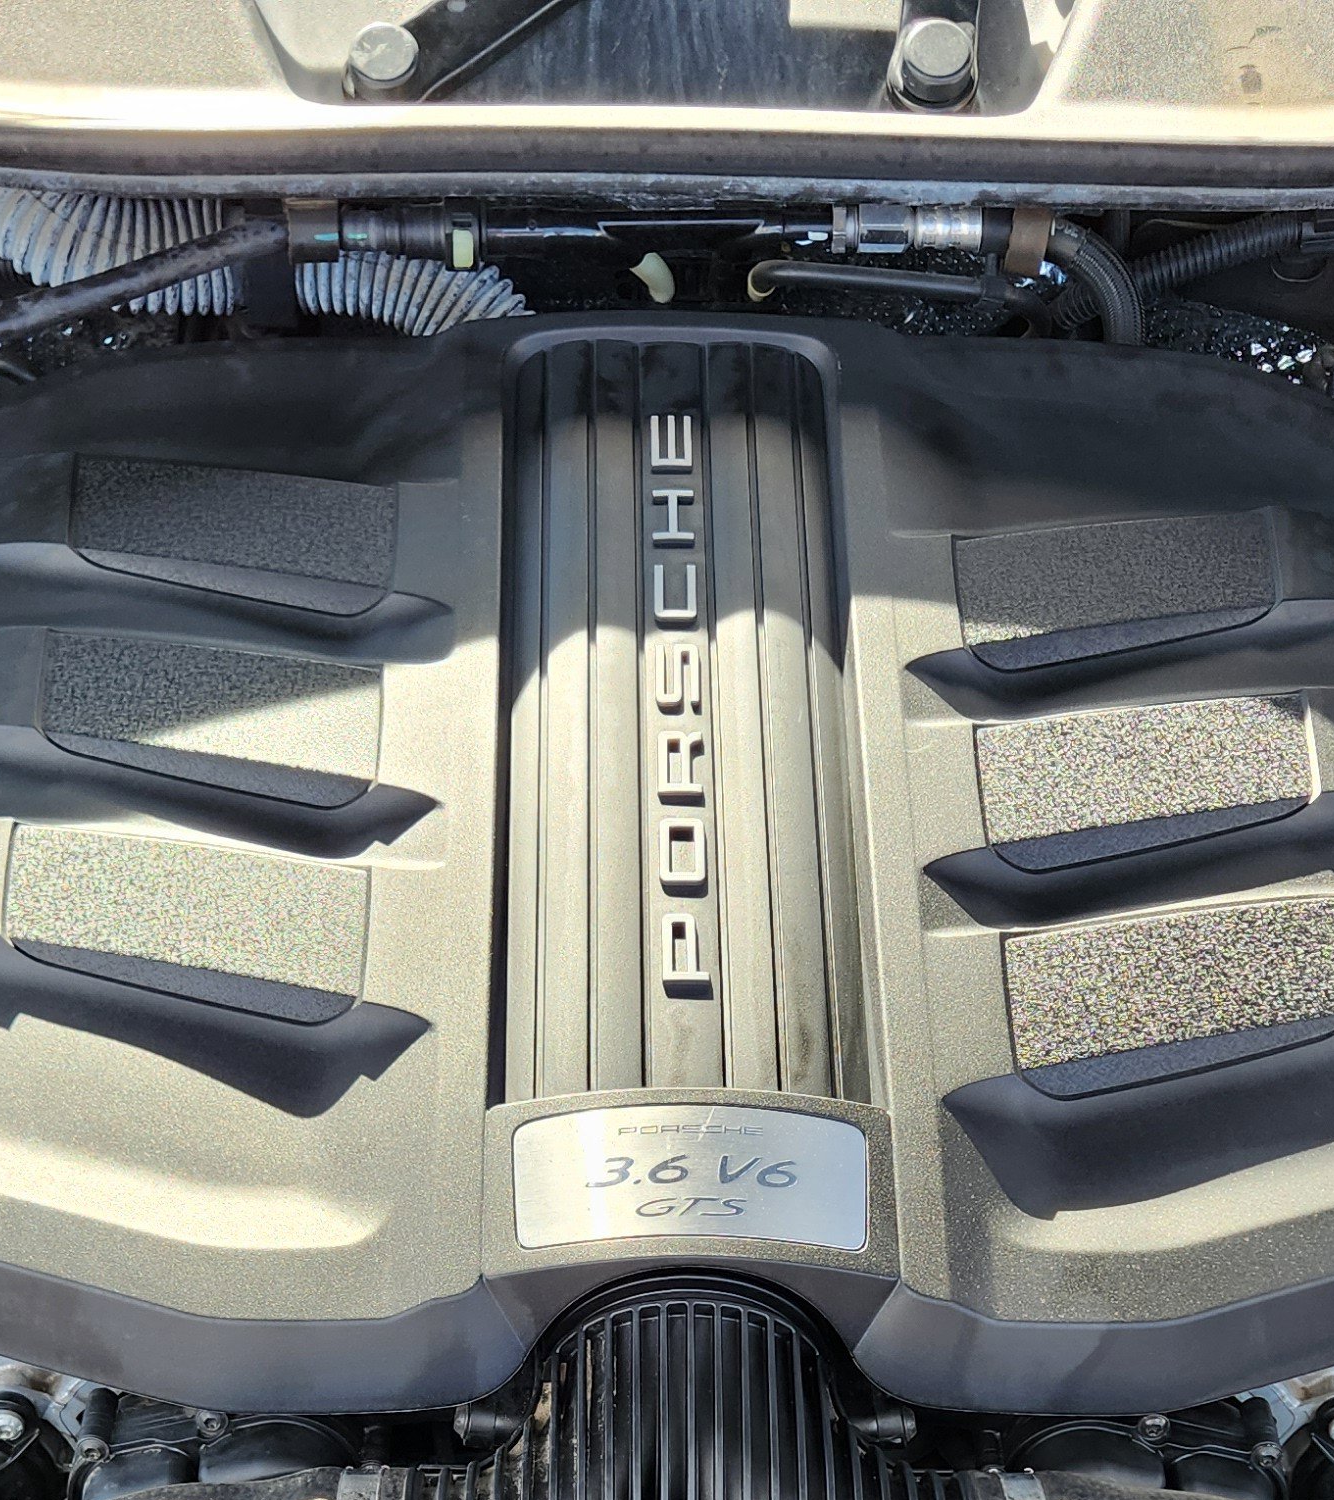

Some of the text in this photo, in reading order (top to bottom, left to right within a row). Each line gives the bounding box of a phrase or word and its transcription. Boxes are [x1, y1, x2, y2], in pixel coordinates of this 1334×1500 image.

[650, 414, 711, 986] PORSCHE
[618, 1124, 764, 1136] PORSCHE
[585, 1154, 798, 1188] 3.6 V6
[635, 1196, 749, 1218] GTS
